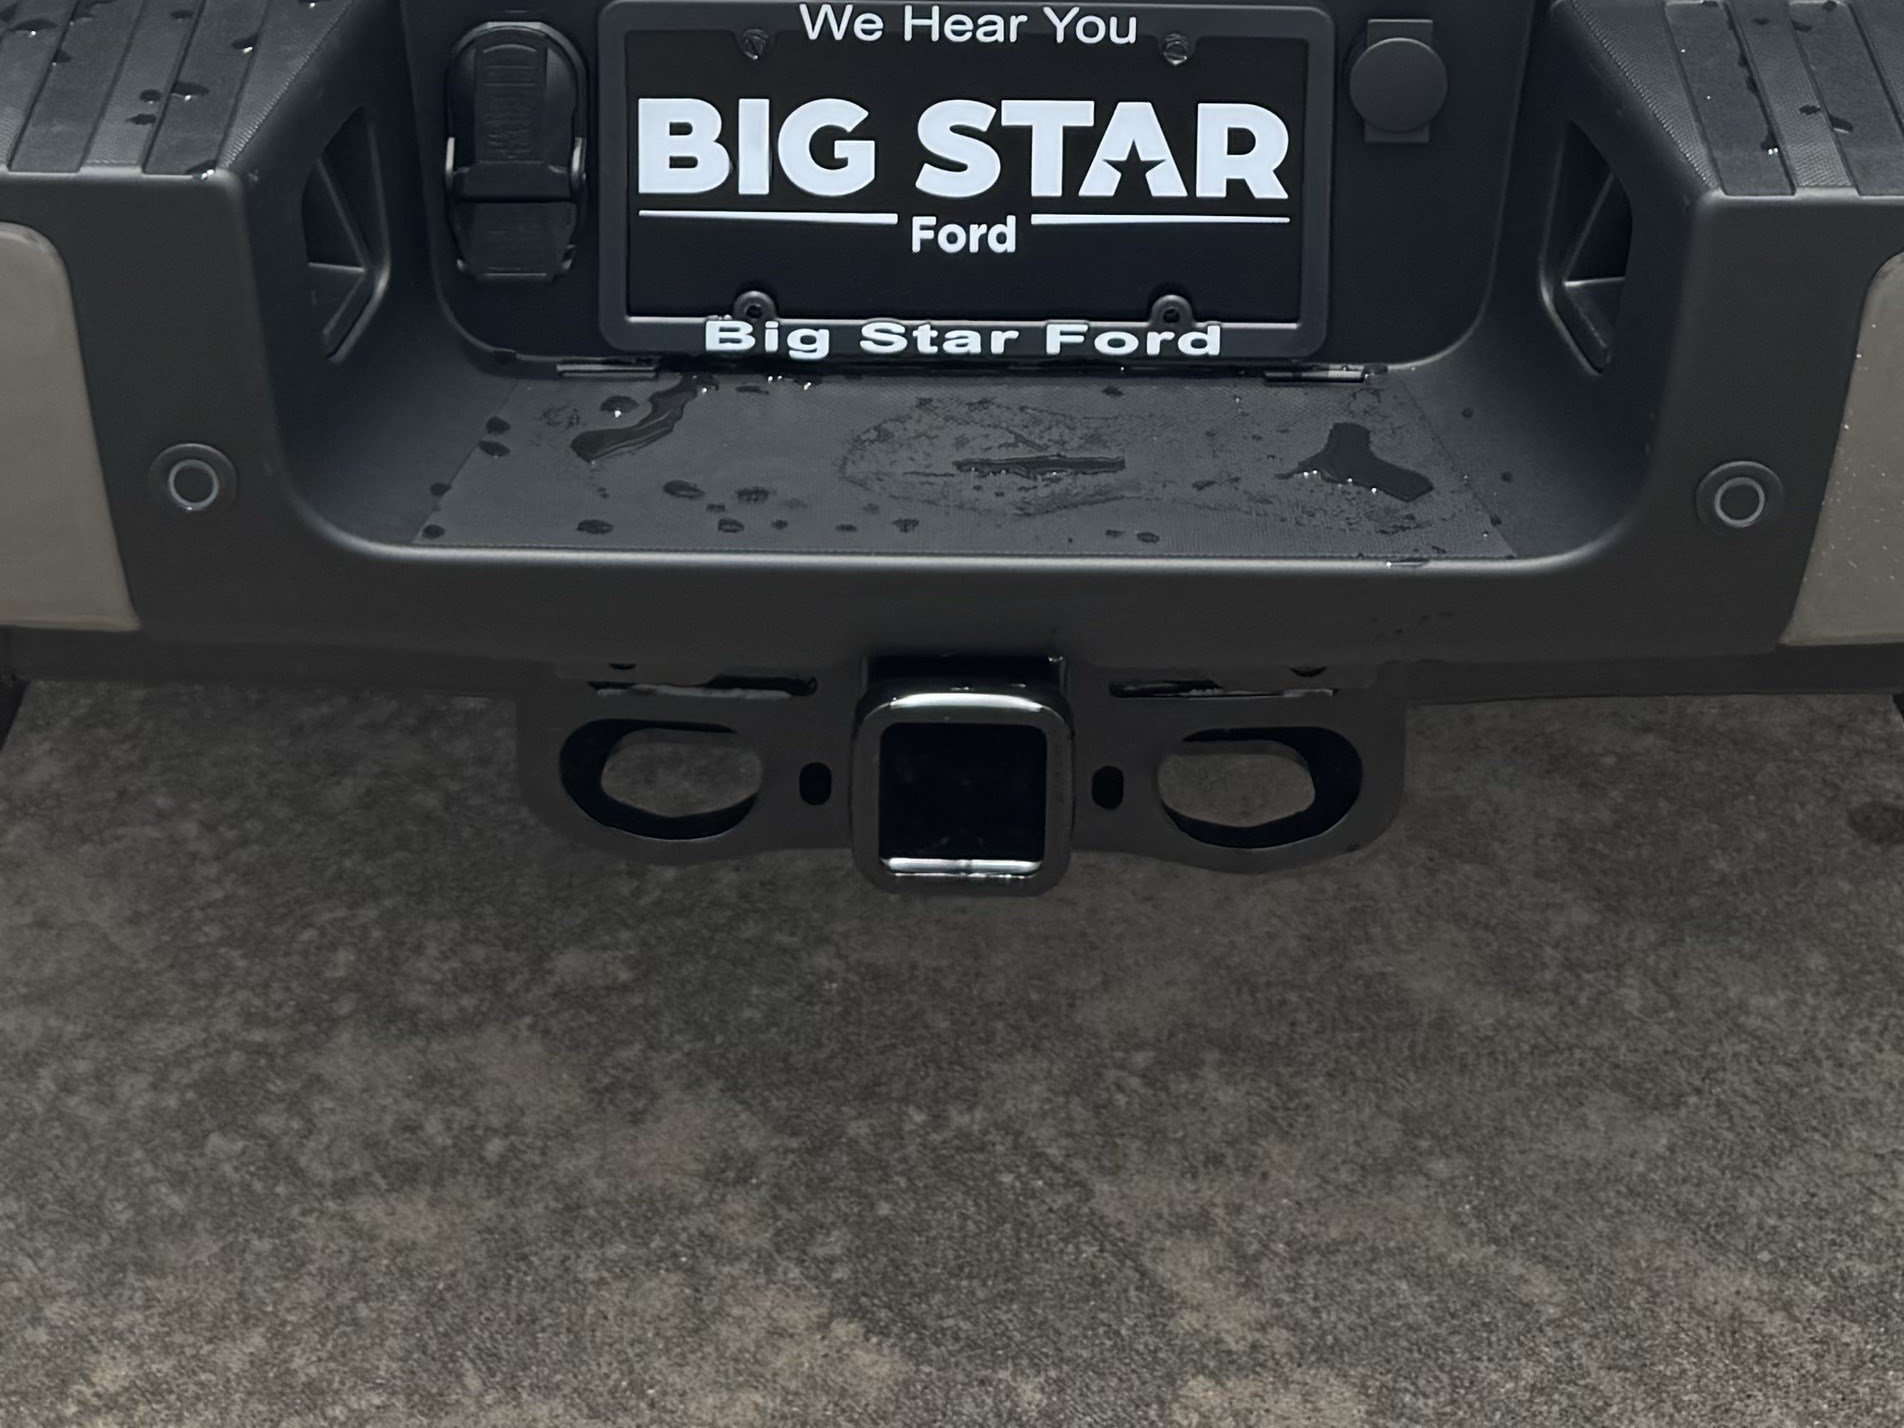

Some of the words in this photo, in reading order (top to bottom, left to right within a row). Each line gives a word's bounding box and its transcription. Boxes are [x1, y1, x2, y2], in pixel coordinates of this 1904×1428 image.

[799, 4, 884, 41] We
[904, 5, 1027, 43] Hear
[1043, 7, 1137, 45] You
[638, 97, 876, 196] BIG
[915, 99, 1289, 199] STAR
[911, 215, 1017, 253] Ford
[705, 320, 829, 360] Big
[859, 321, 1019, 355] Star
[1045, 323, 1221, 357] Ford
